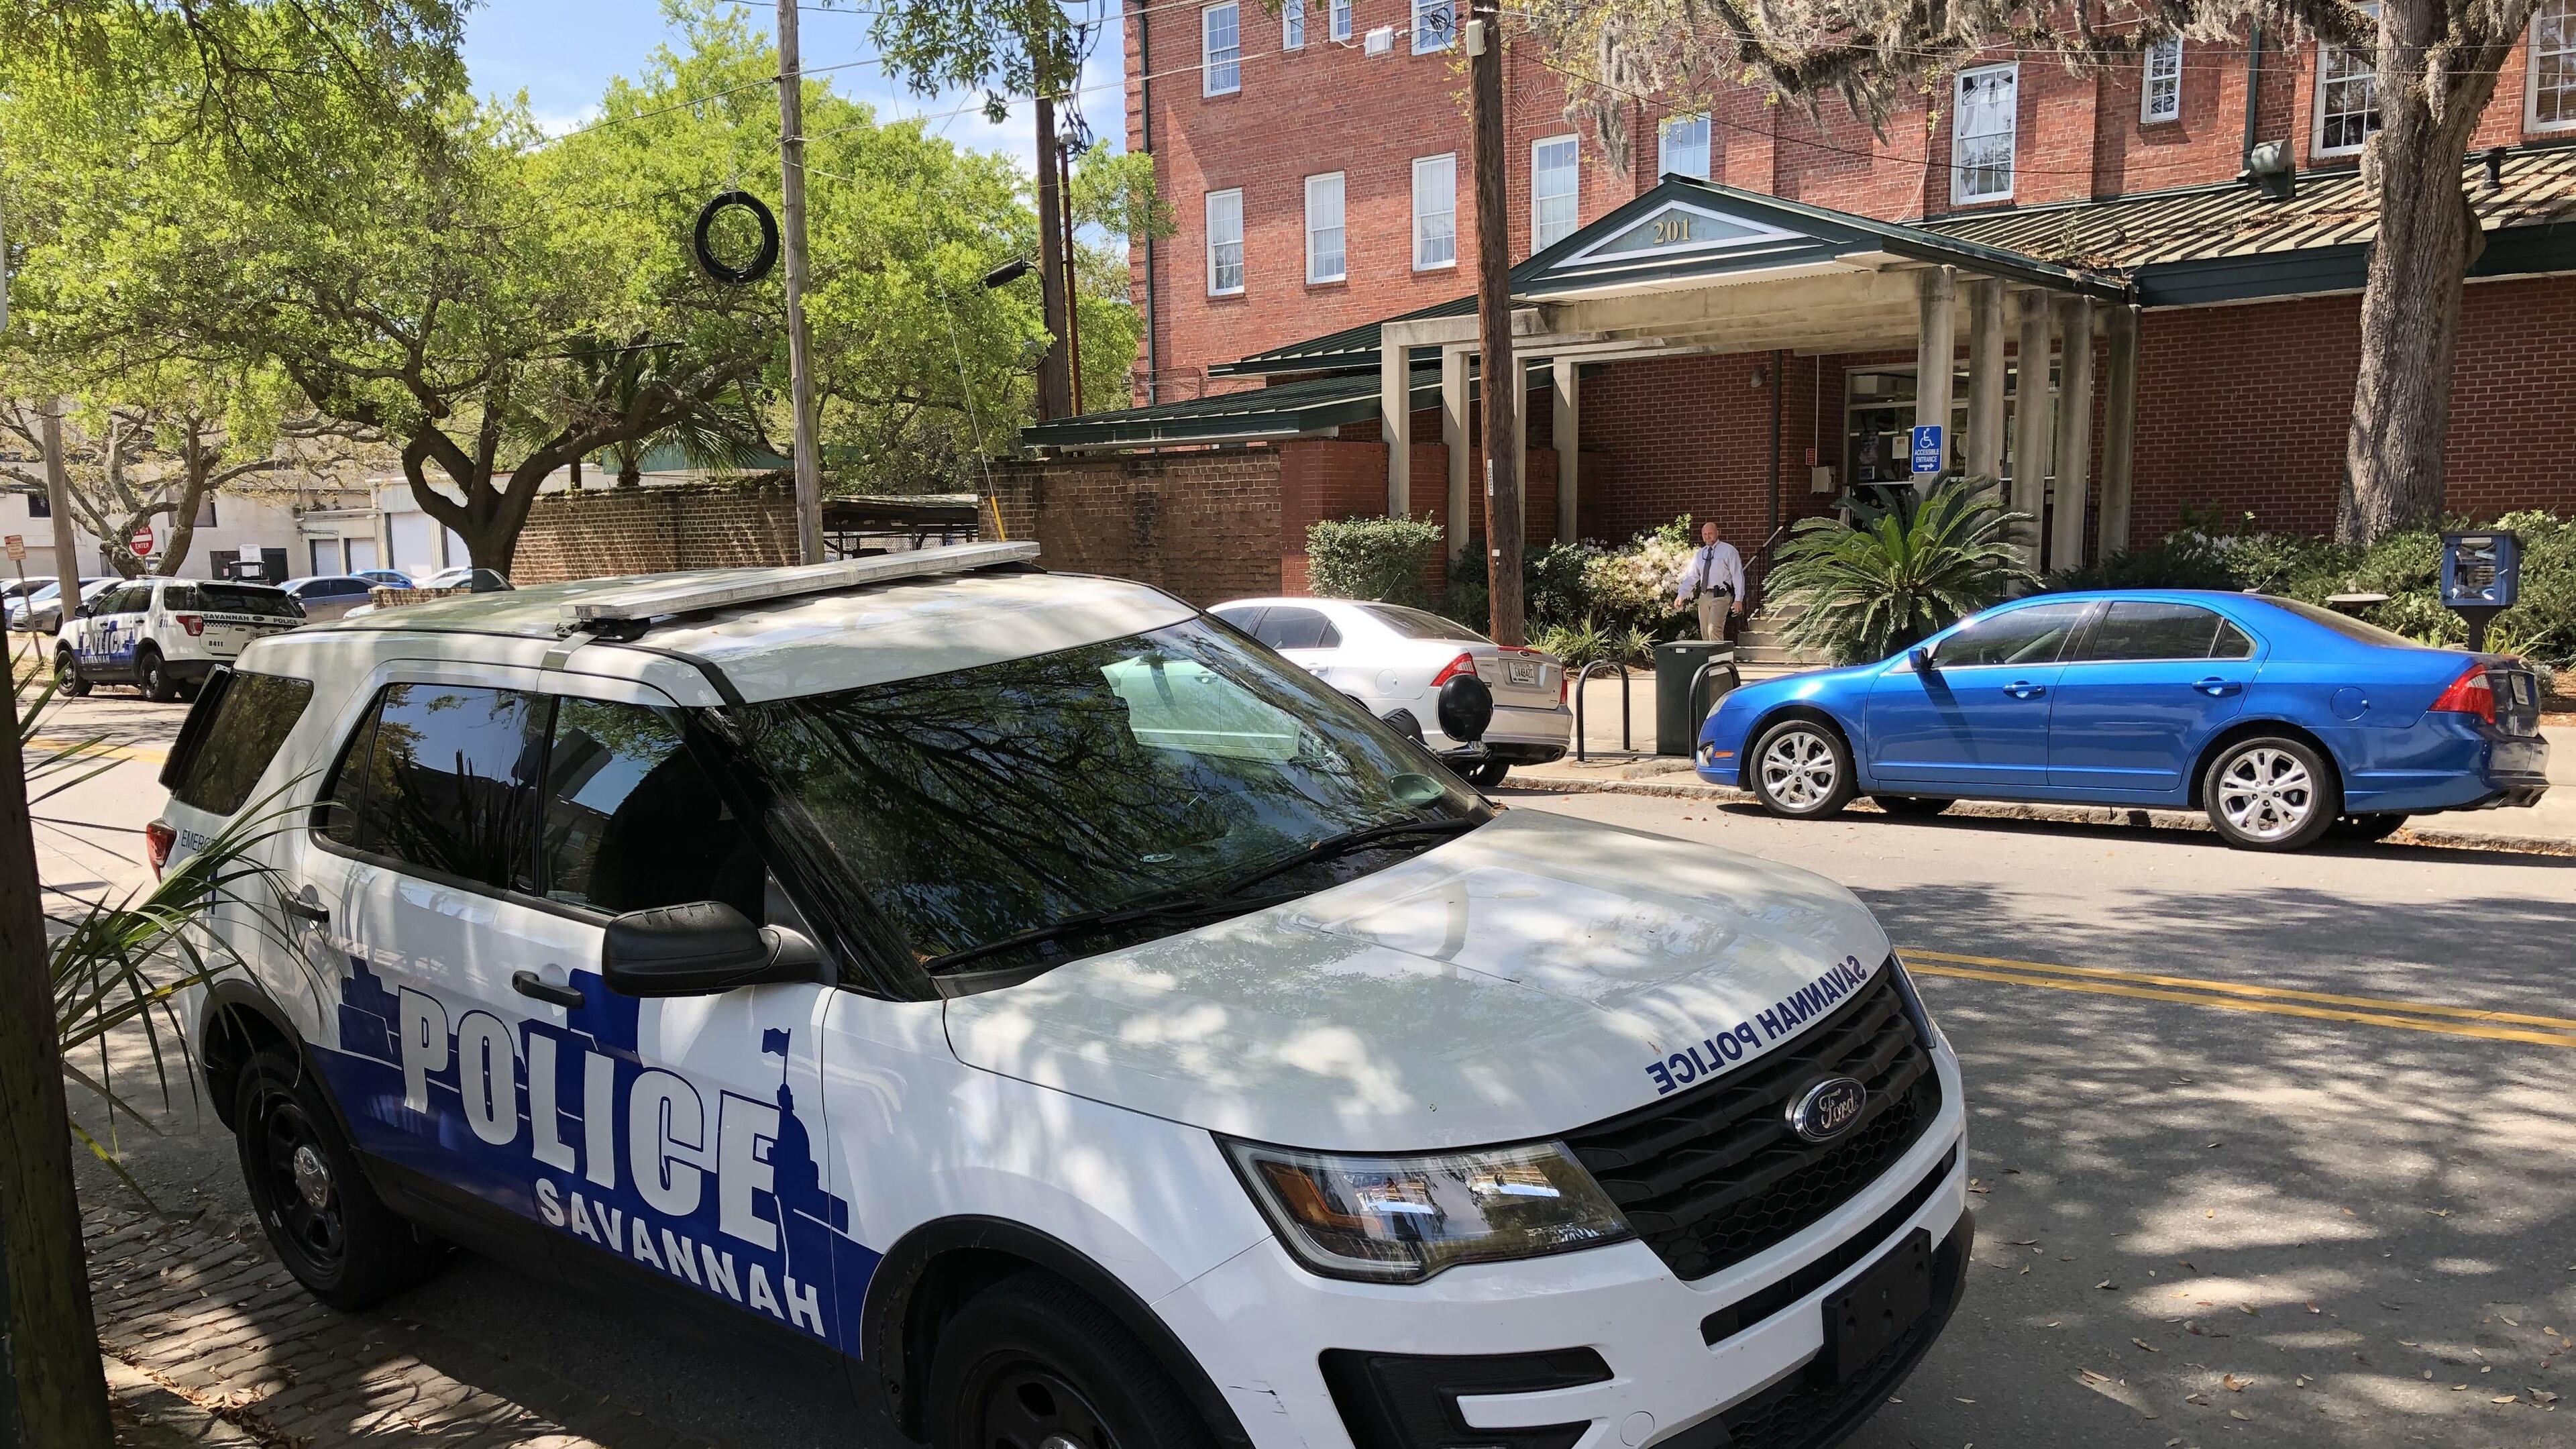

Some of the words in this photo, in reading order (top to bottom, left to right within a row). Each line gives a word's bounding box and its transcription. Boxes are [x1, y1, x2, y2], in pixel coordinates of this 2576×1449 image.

[1652, 217, 1690, 244] 201
[1915, 448, 1940, 456] ACCESSIBLE
[159, 619, 168, 628] 911
[203, 613, 250, 621] SAVANNAH
[82, 631, 126, 655] POLICE
[80, 655, 110, 664] SAVANNAH
[398, 985, 780, 1252] POLICE
[1819, 1087, 1856, 1129] Ford
[536, 1178, 826, 1338] SAVANNAH
